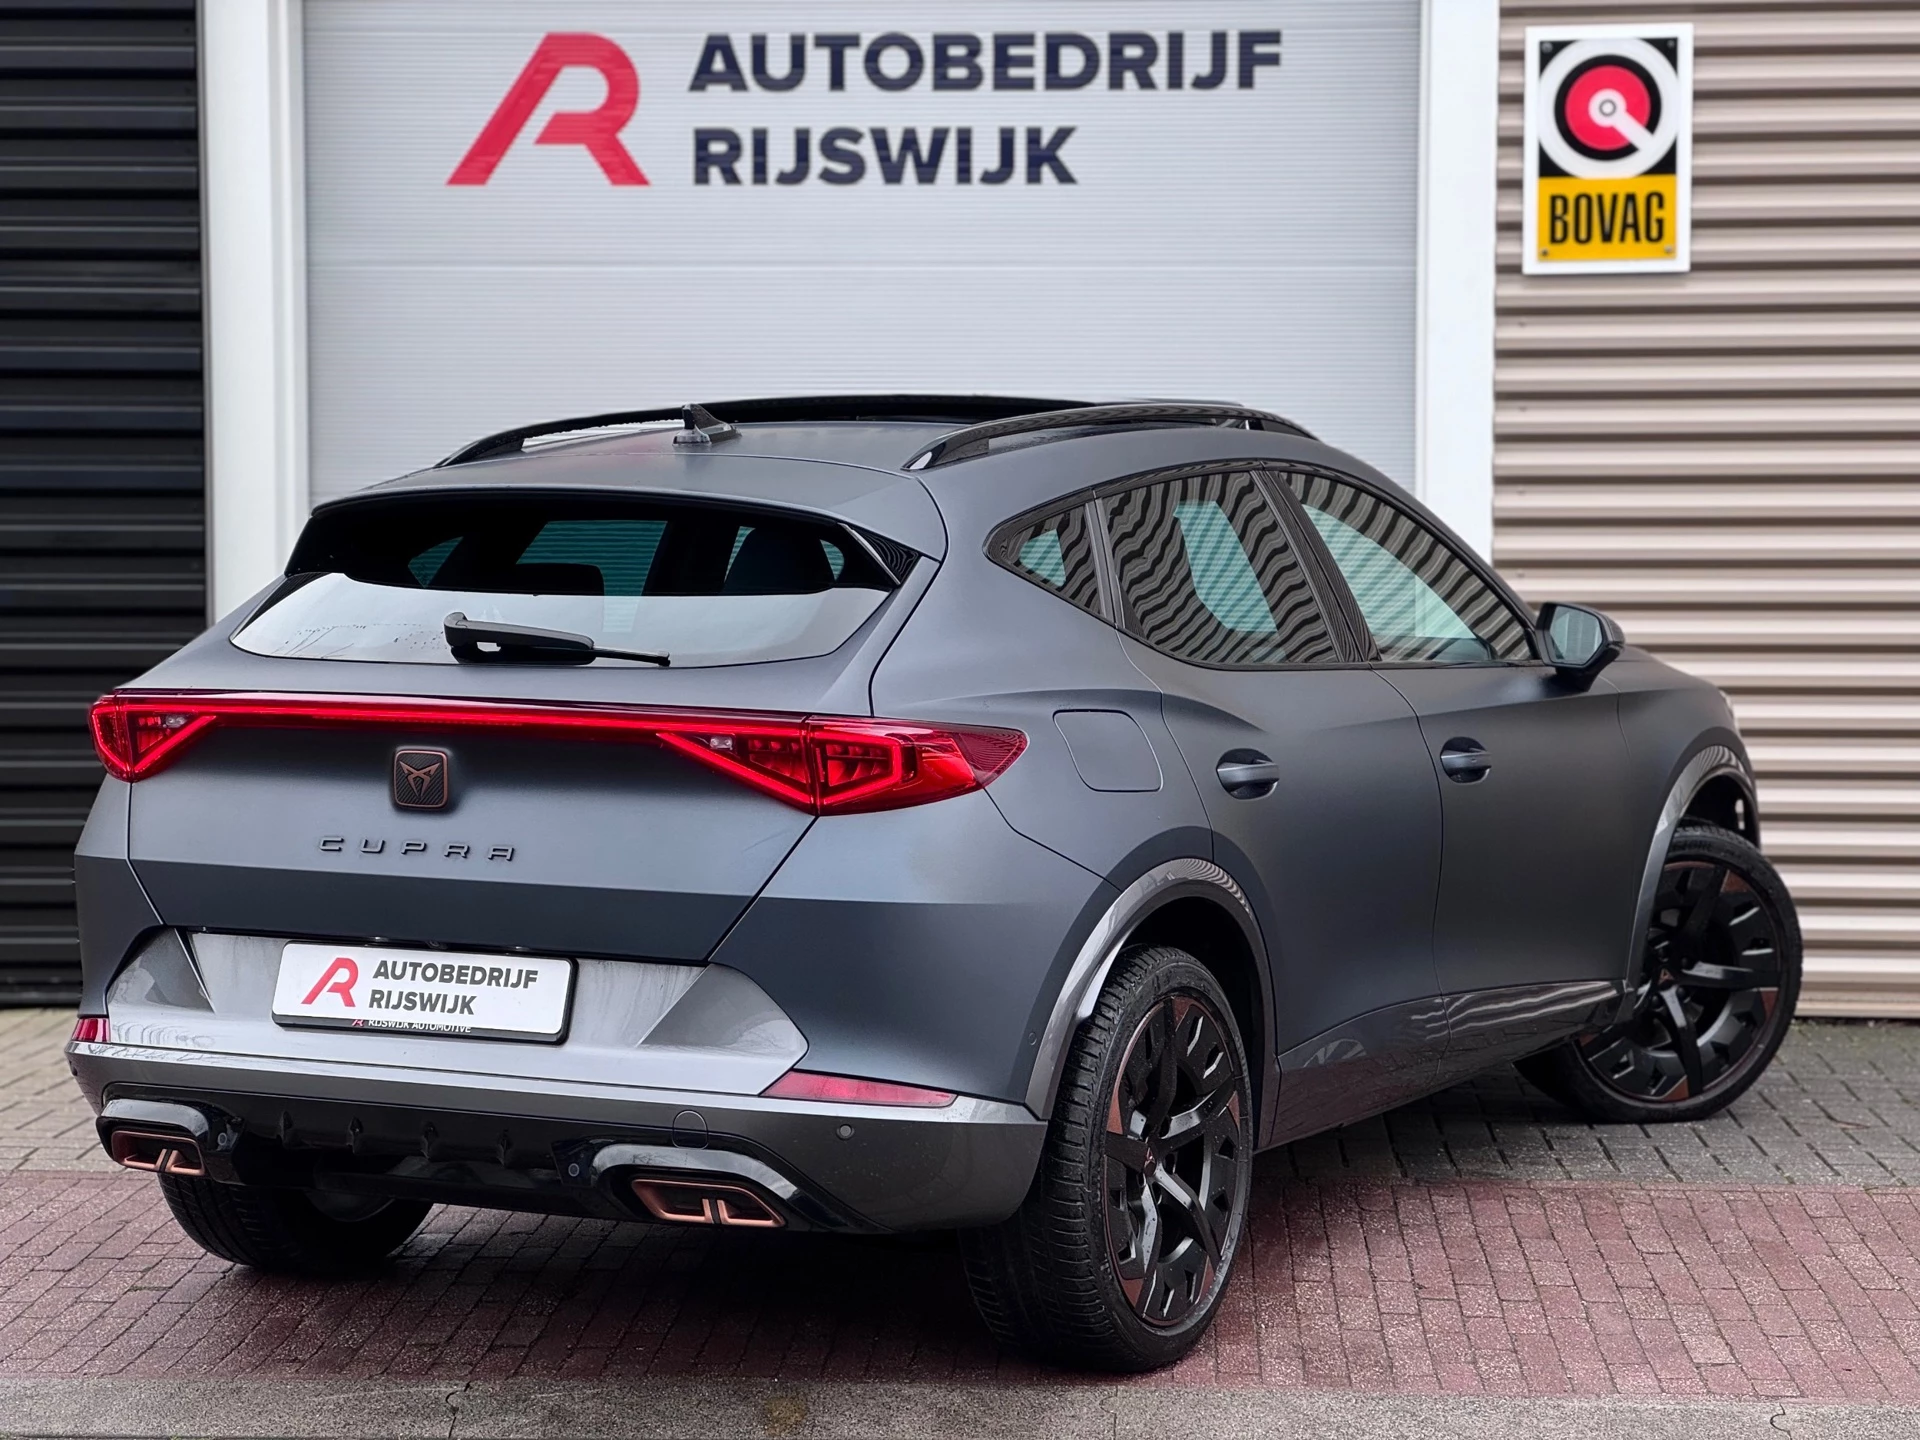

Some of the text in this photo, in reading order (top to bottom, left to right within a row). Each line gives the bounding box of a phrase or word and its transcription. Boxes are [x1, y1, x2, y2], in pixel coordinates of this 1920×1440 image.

[688, 30, 1282, 92] AUTOBEDRIJF
[693, 126, 1078, 187] RIJSWIJK
[1549, 191, 1665, 244] BOVAG
[319, 836, 515, 862] CUPRA
[372, 959, 539, 990] AUTOBEDRIJF
[368, 989, 477, 1015] RIJSWIJK
